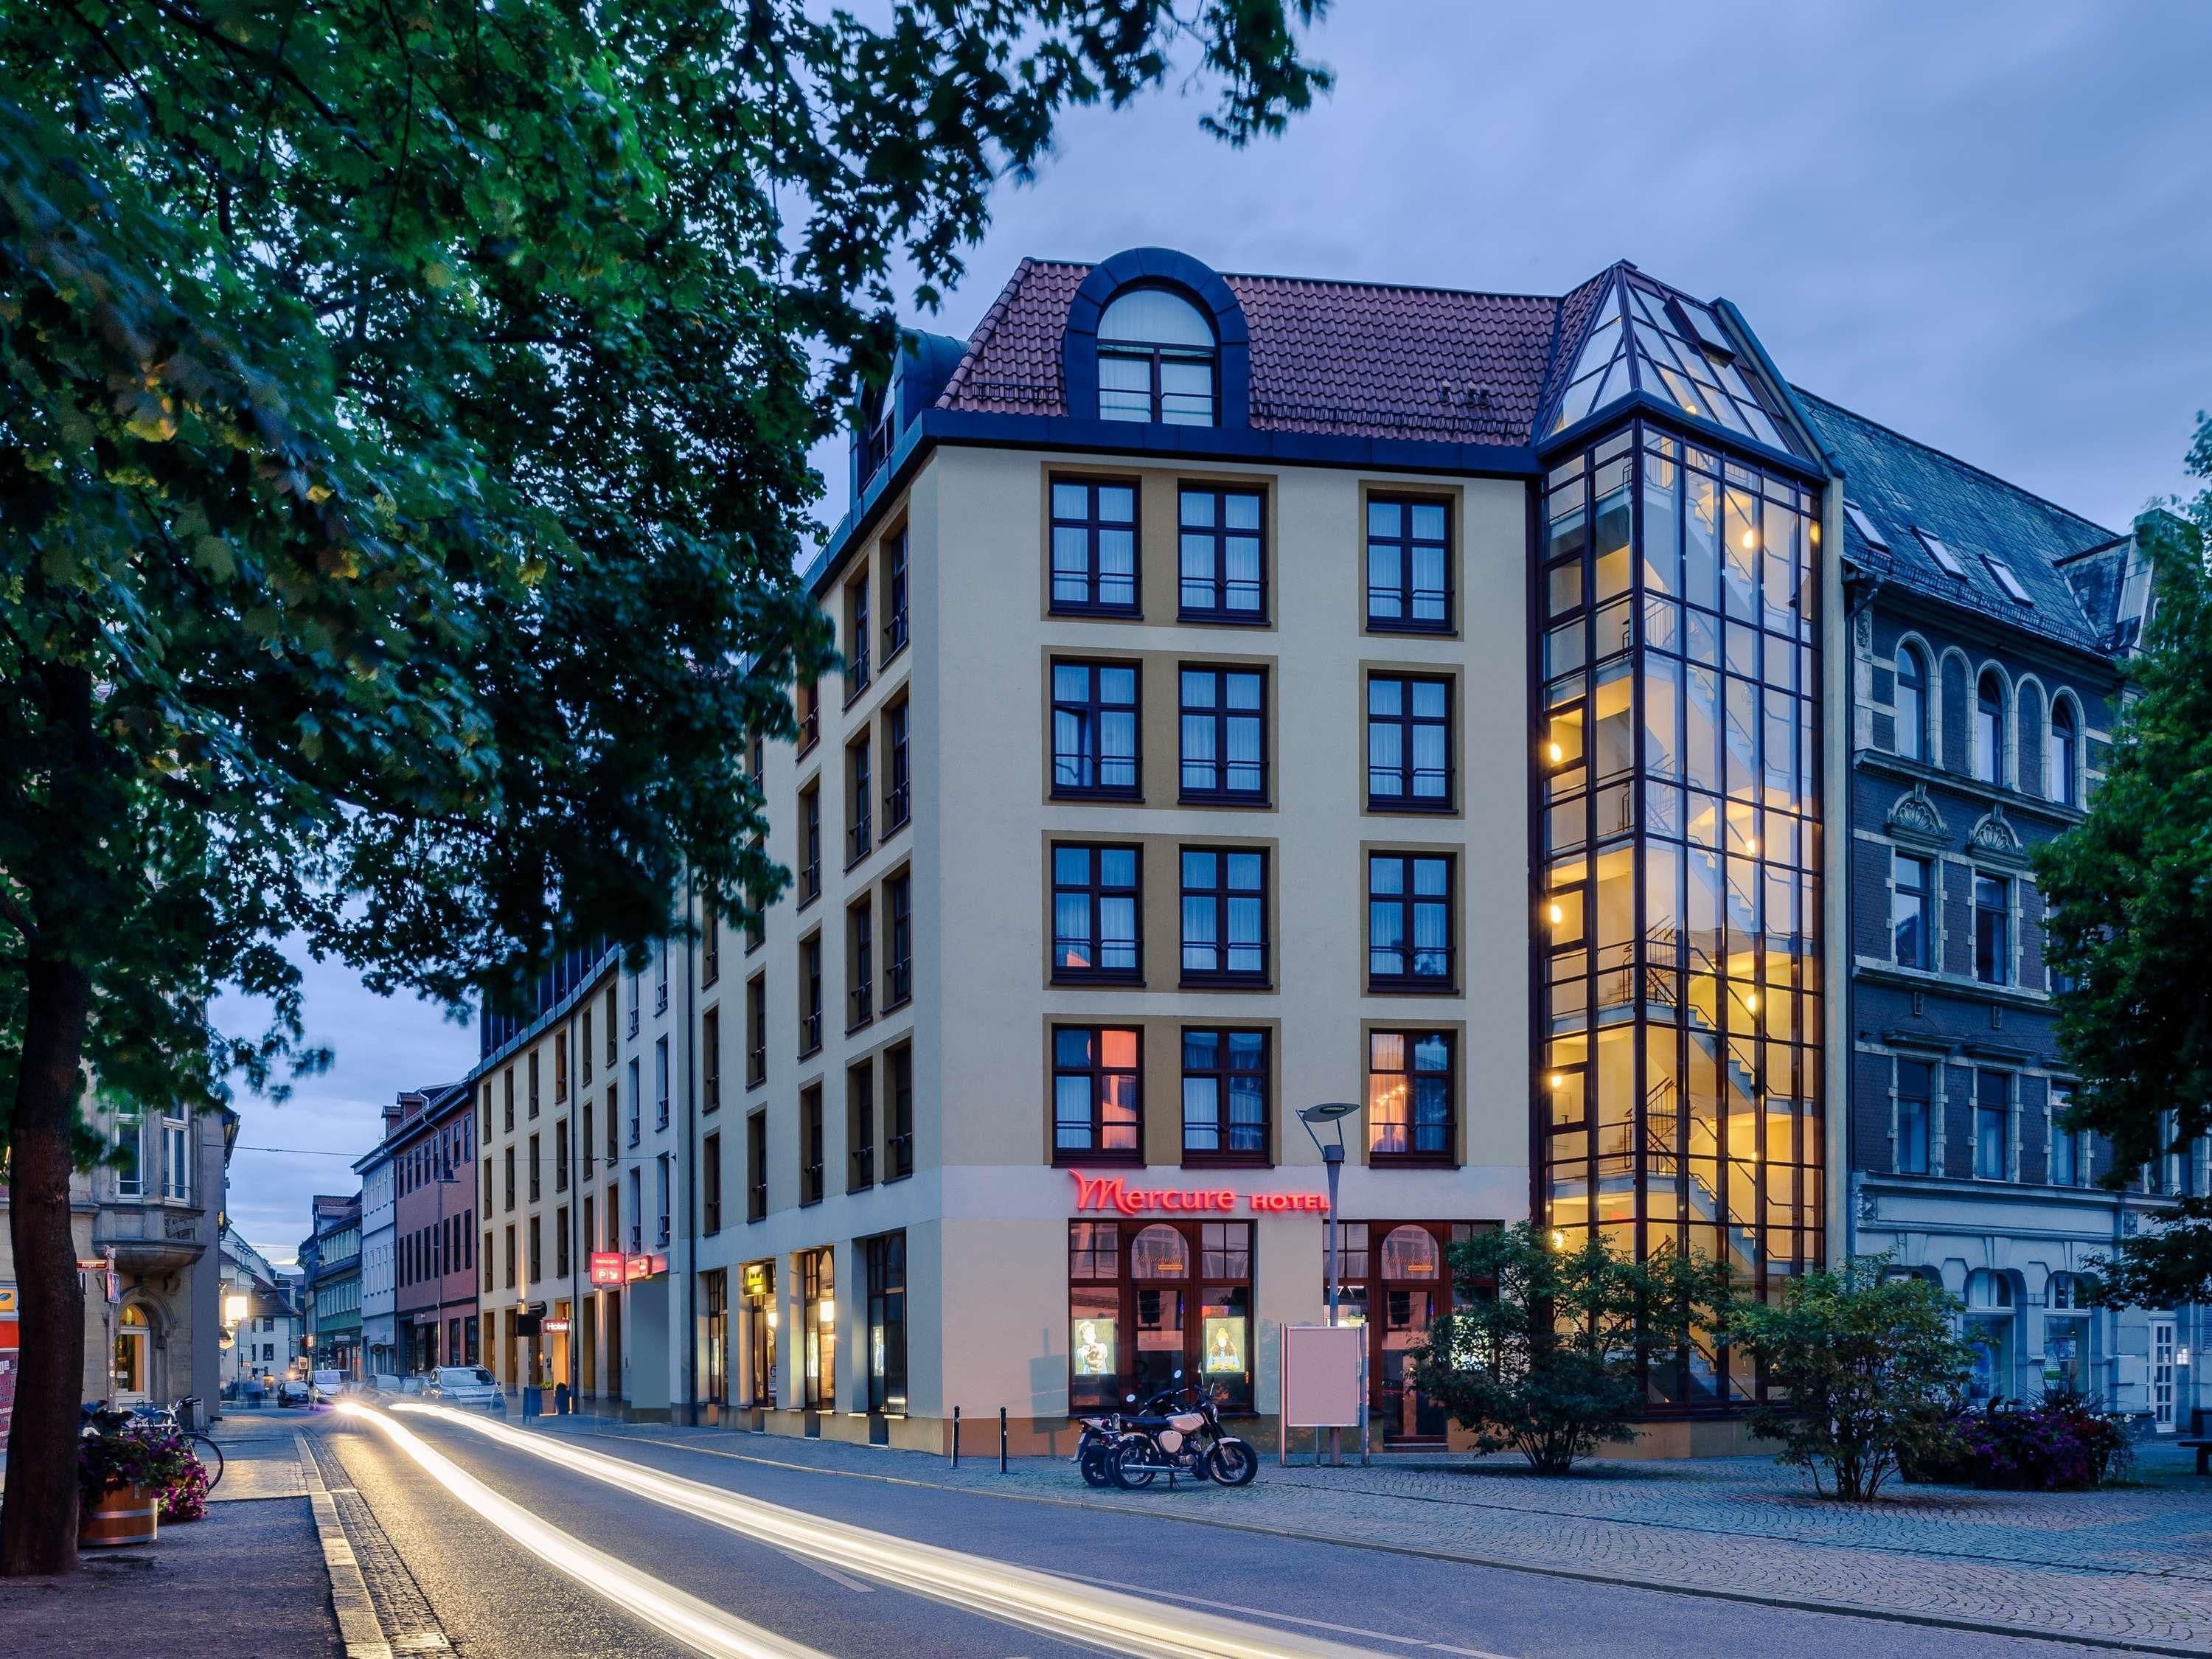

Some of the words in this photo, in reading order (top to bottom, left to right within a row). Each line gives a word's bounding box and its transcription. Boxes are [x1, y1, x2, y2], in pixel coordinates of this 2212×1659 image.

[1068, 1168, 1235, 1214] Mercure
[1251, 1194, 1330, 1211] HOTEL
[546, 1322, 567, 1331] Hotel
